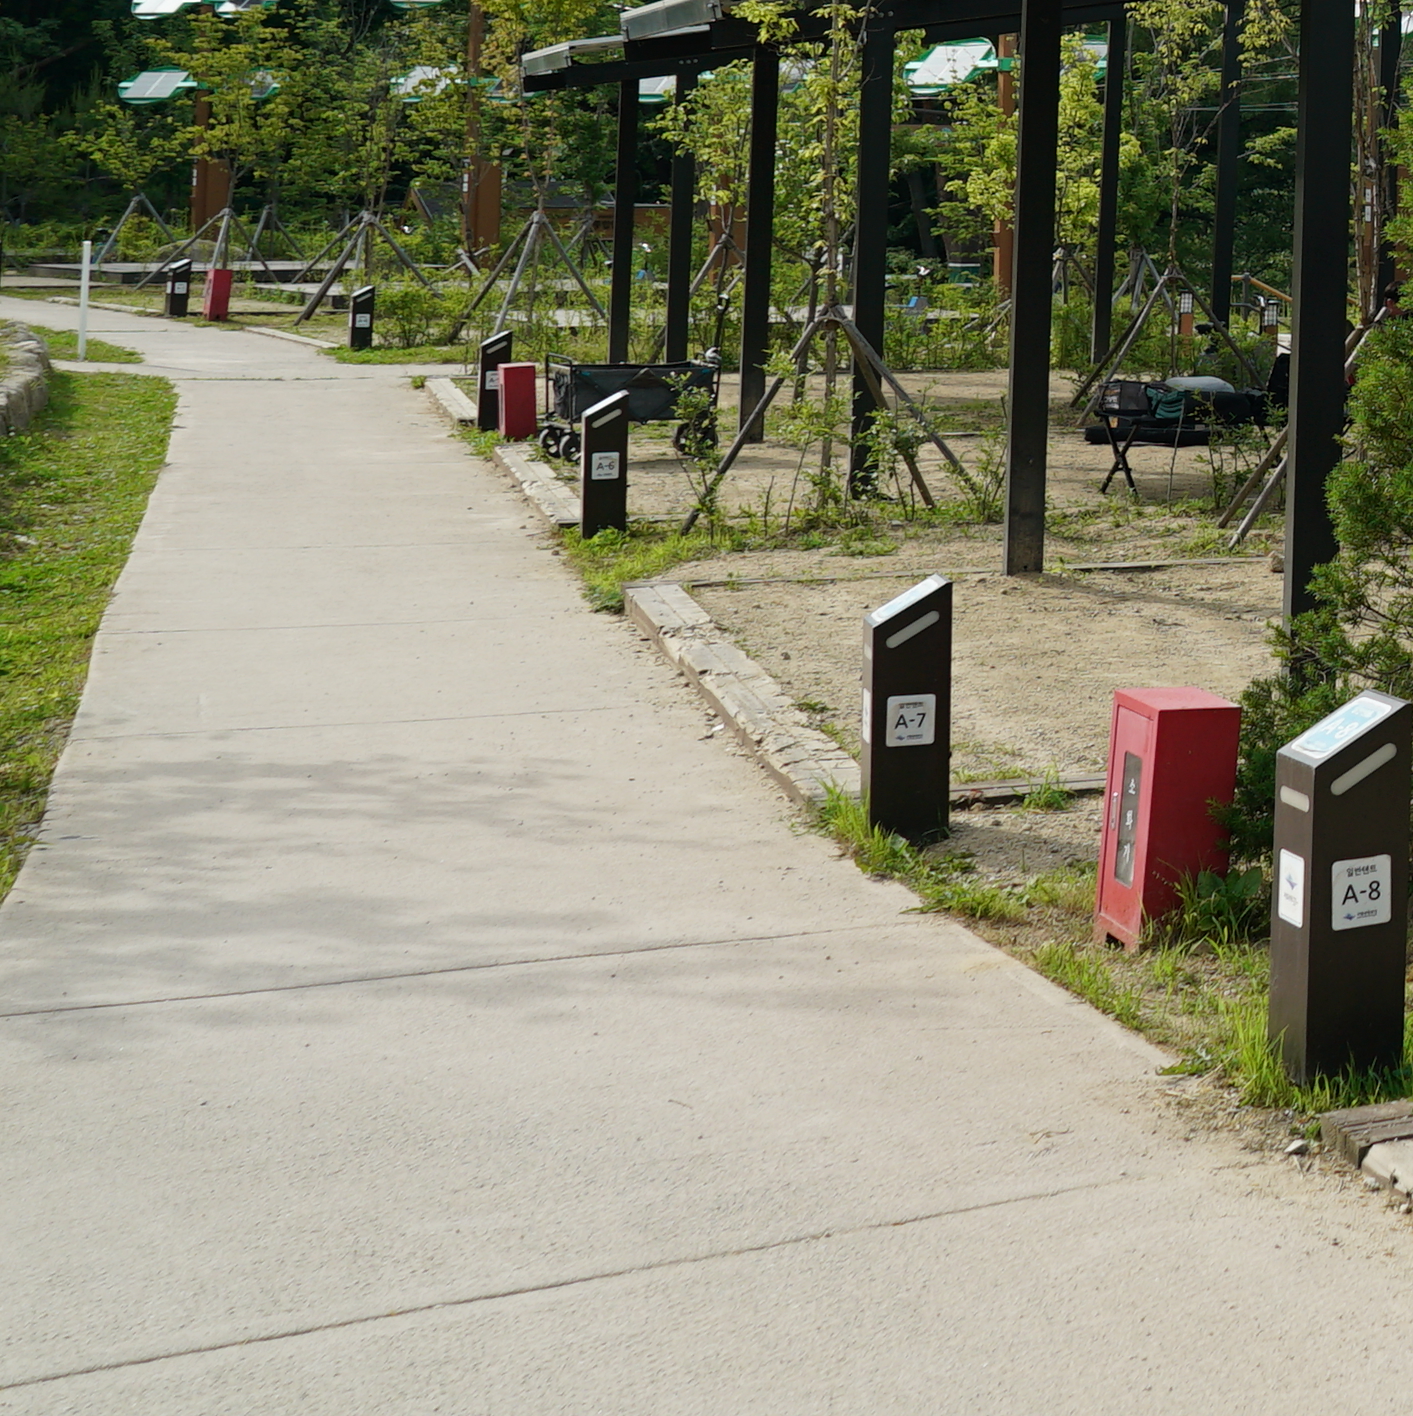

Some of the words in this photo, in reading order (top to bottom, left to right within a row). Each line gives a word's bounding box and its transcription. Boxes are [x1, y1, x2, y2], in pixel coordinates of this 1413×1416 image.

[596, 460, 615, 471] A-6
[894, 712, 927, 730] A-7
[1320, 717, 1359, 740] A-8
[1342, 880, 1381, 906] A-8
